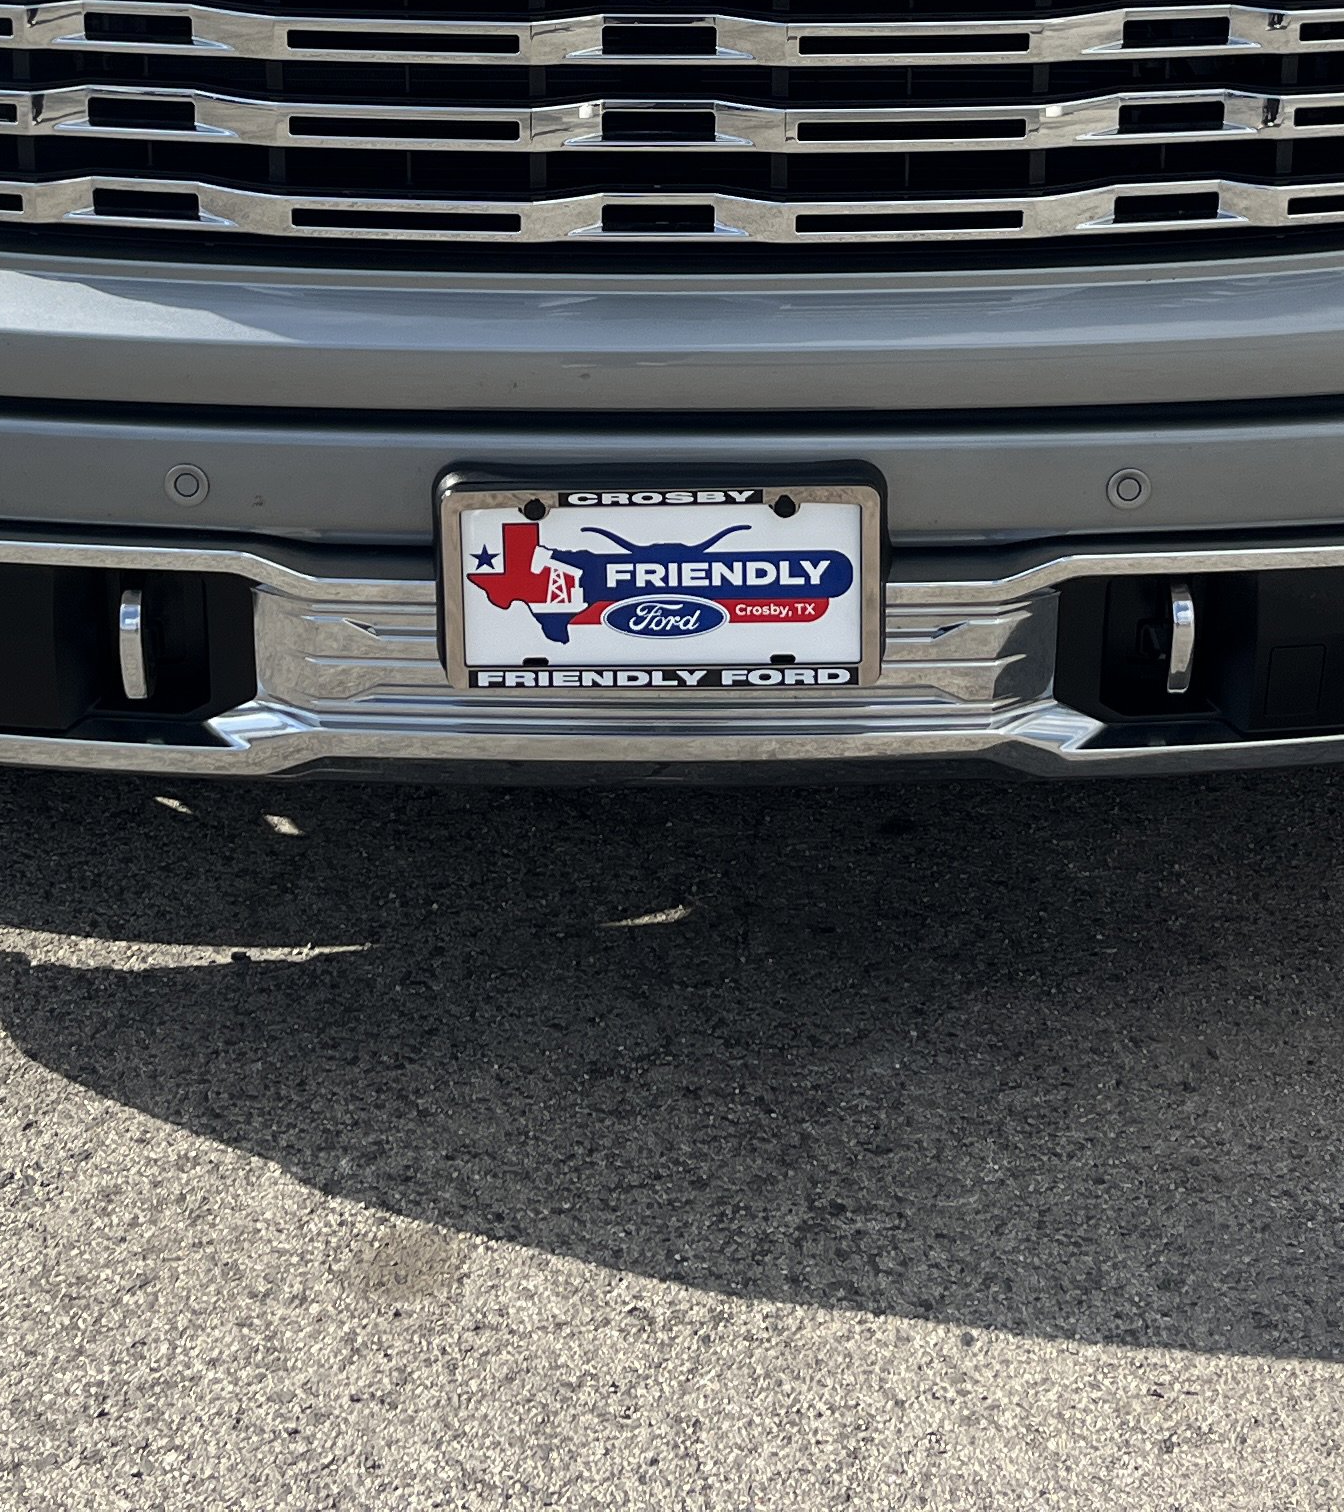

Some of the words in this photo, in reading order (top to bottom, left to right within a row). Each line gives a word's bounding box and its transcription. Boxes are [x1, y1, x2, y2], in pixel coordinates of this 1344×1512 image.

[566, 489, 756, 506] CROSBY
[605, 560, 831, 590] FRIENDLY
[629, 602, 700, 632] Ford
[734, 602, 793, 619] Crosby,
[794, 602, 816, 616] TX
[477, 668, 703, 688] FRIENDLY
[721, 667, 851, 687] FORD
